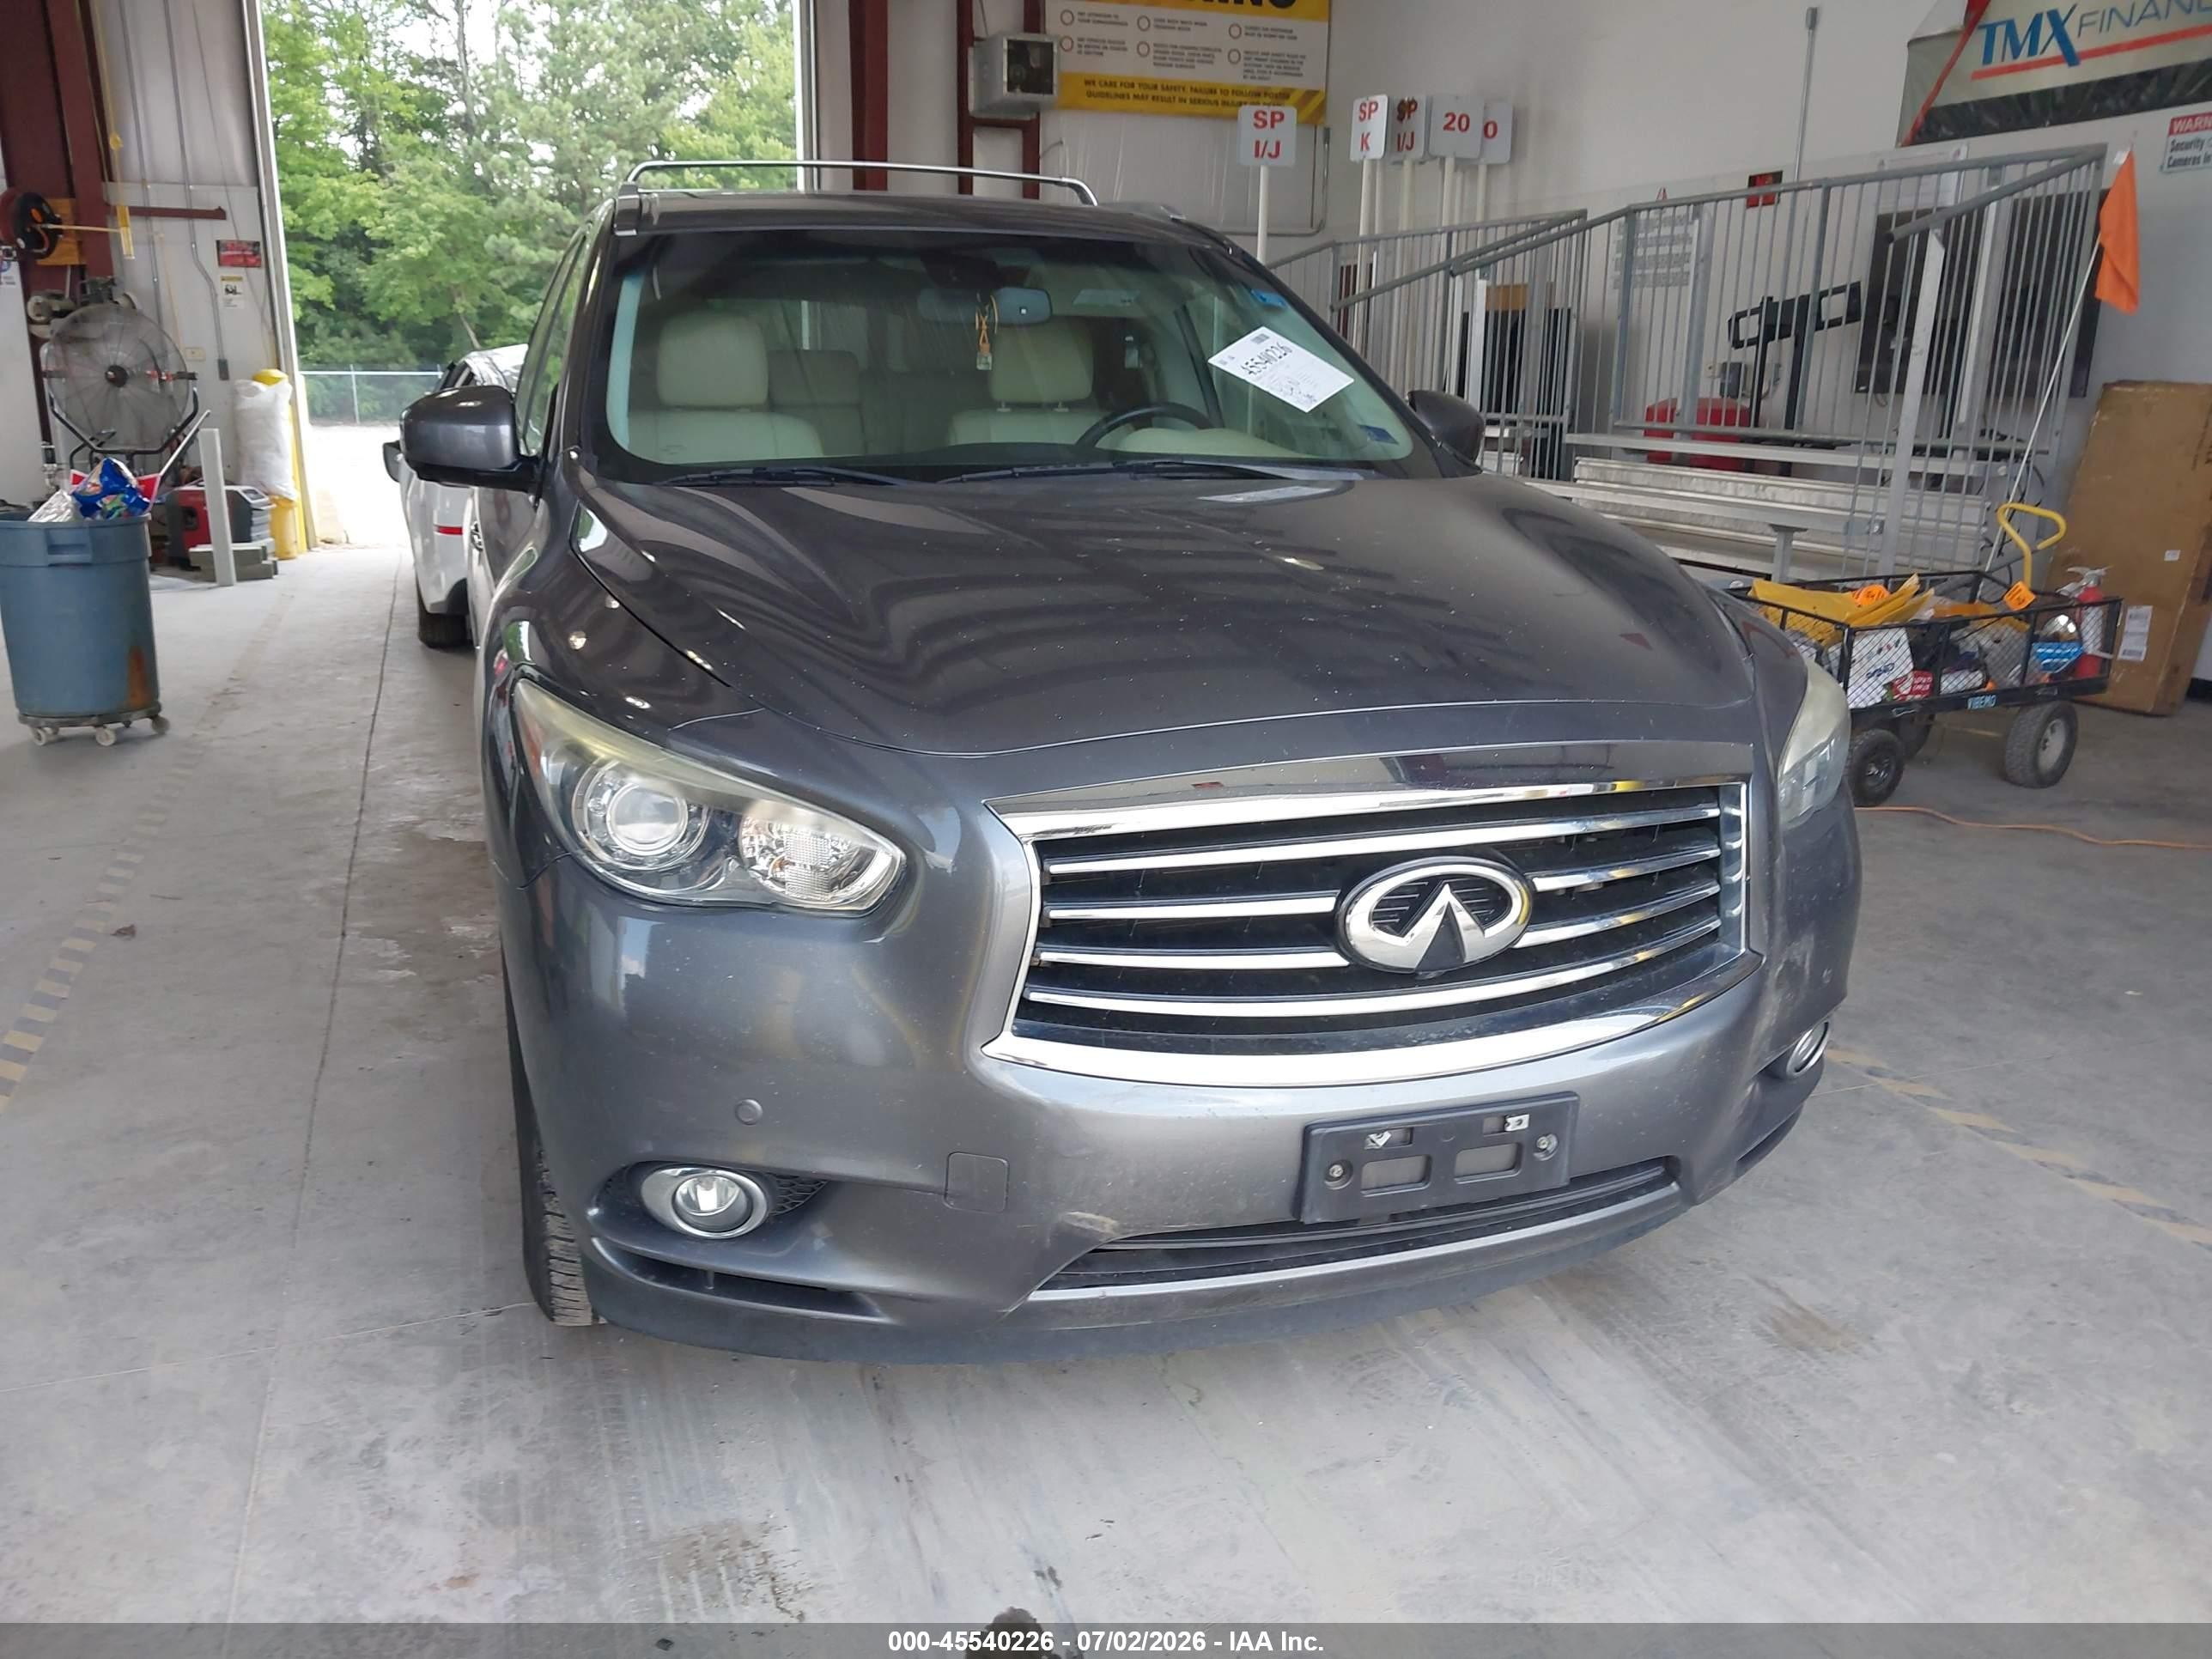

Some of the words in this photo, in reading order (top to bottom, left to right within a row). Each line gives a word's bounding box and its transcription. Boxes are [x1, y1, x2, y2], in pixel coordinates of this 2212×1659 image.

[1978, 3, 2081, 67] TMX
[2077, 0, 2212, 39] FINAN
[1086, 90, 1130, 100] GUIDELINES
[1253, 110, 1285, 129] SP
[1358, 101, 1378, 122] SP
[1443, 112, 1470, 132] 20
[1253, 140, 1280, 159] I/J
[1360, 132, 1370, 152] K
[1396, 131, 1415, 152] I/J
[2171, 137, 2205, 153] Security
[2166, 155, 2202, 168] Cameras
